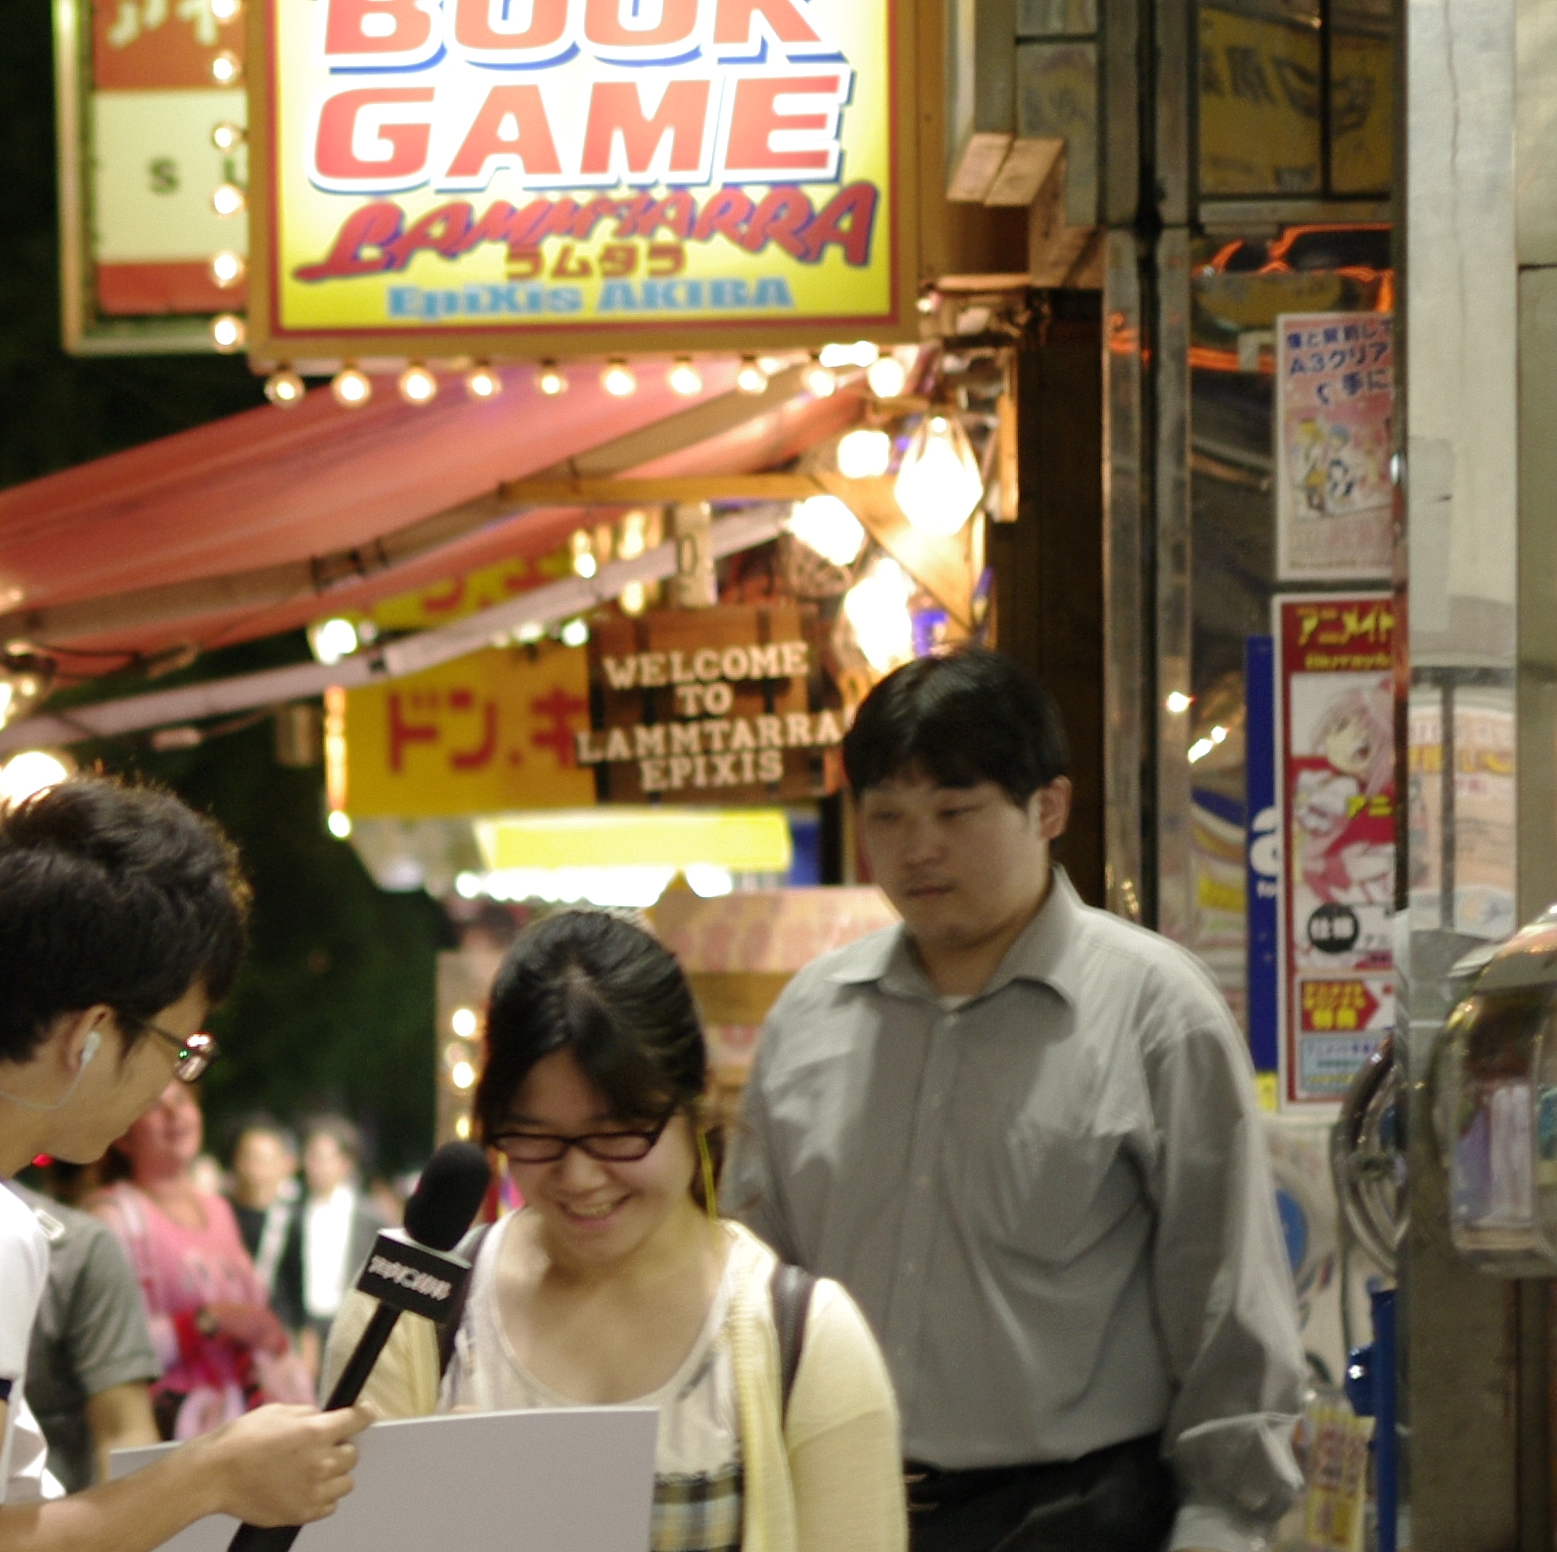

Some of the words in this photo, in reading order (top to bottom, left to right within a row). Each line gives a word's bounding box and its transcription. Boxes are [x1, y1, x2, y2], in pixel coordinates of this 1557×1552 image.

[309, 70, 849, 190] GAME
[504, 243, 688, 280] ラムタラ
[596, 275, 796, 314] AKIBA
[602, 641, 810, 691] WELCOME
[674, 682, 734, 718] TO
[575, 708, 843, 766] LAMMTARRA
[640, 749, 784, 792] EPIXIS
